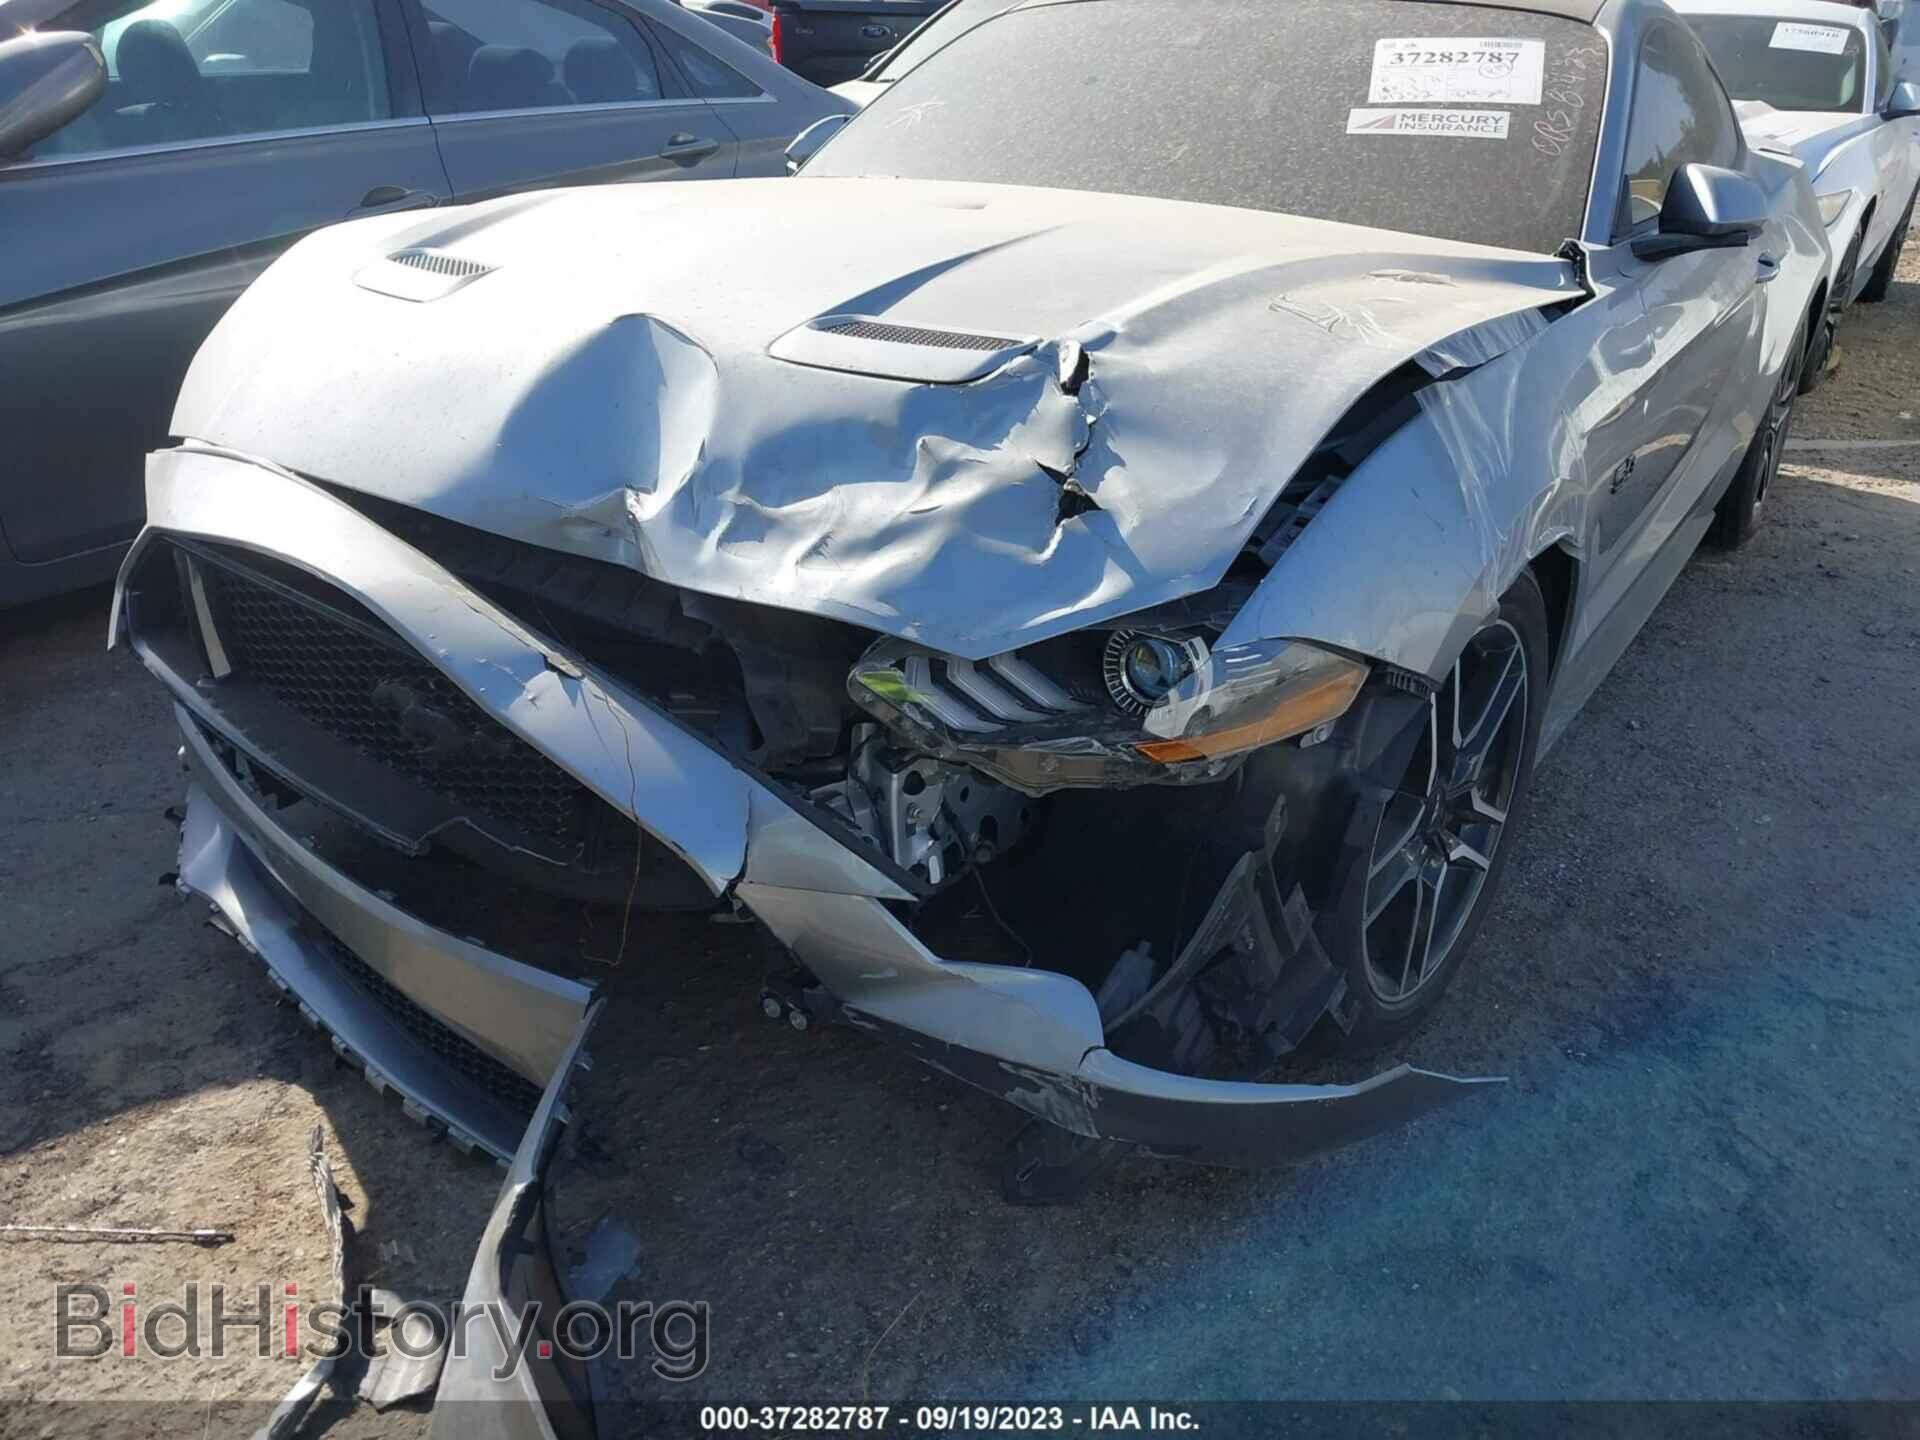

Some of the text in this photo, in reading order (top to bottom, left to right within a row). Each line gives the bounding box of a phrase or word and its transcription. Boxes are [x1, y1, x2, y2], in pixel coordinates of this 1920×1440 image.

[1389, 51, 1520, 65] 37282787
[1400, 112, 1505, 125] MERCURY
[1399, 122, 1504, 134] INSURANCE
